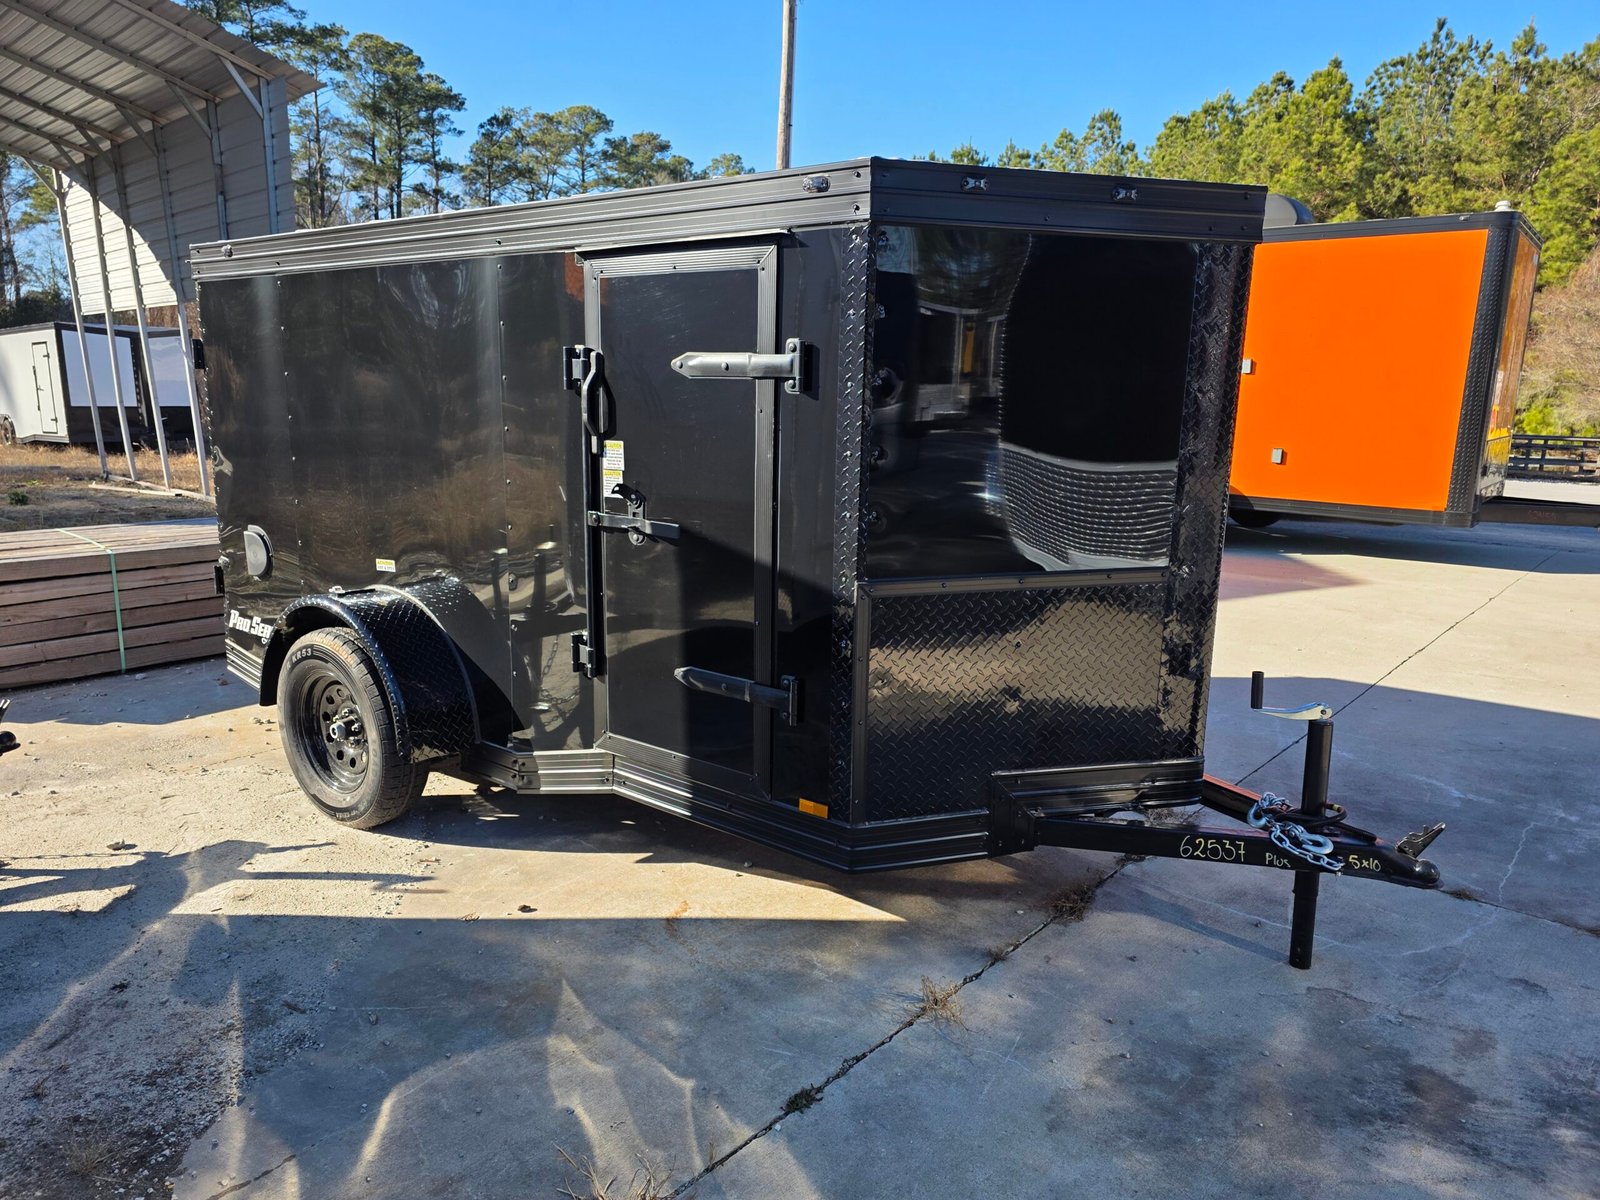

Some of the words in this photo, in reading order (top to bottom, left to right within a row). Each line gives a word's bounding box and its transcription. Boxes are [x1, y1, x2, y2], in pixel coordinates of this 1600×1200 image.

[1180, 835, 1246, 862] 62537
[1265, 852, 1291, 868] Plus
[1349, 854, 1381, 872] 5x10
